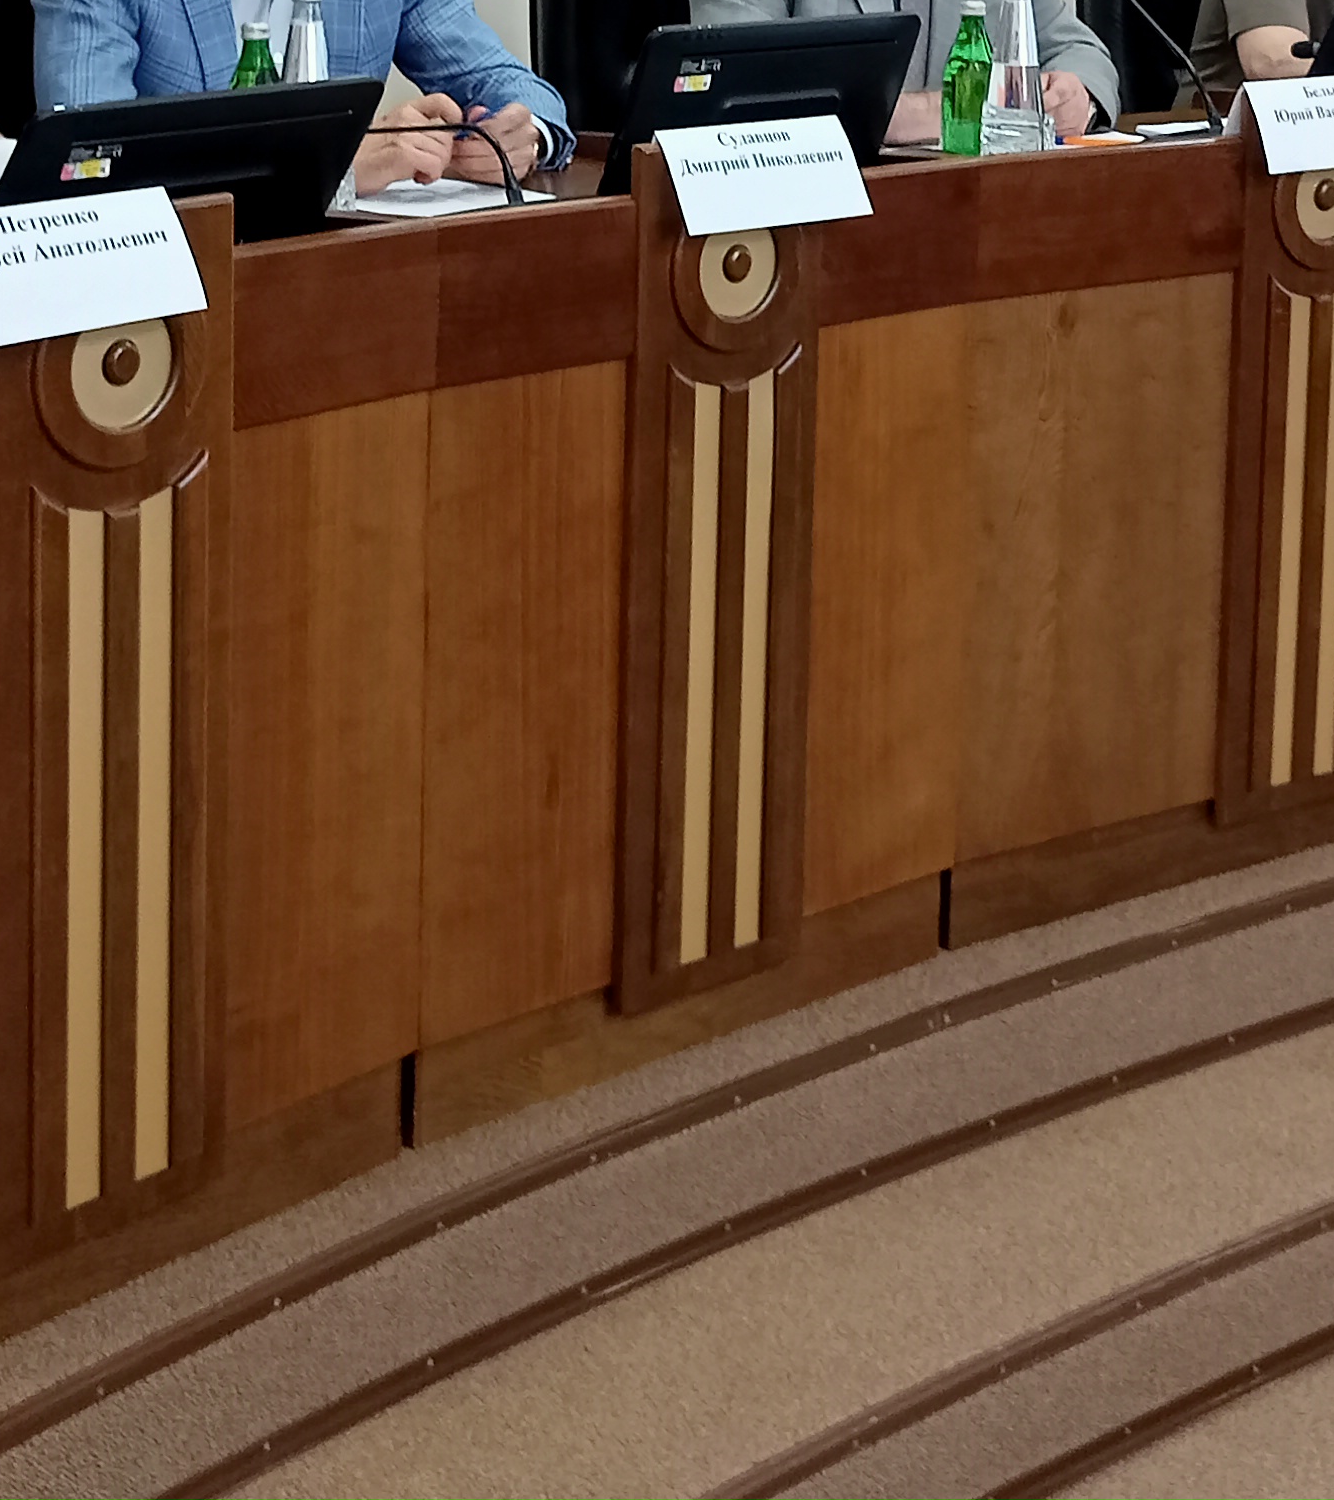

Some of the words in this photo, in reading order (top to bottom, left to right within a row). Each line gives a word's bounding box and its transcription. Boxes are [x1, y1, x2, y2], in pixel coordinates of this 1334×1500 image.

[1273, 107, 1314, 125] Юрий
[716, 130, 792, 150] Судавцов
[680, 154, 750, 177] Дмитрий
[752, 149, 844, 169] Николаевич
[33, 228, 169, 263] Анатольевич
